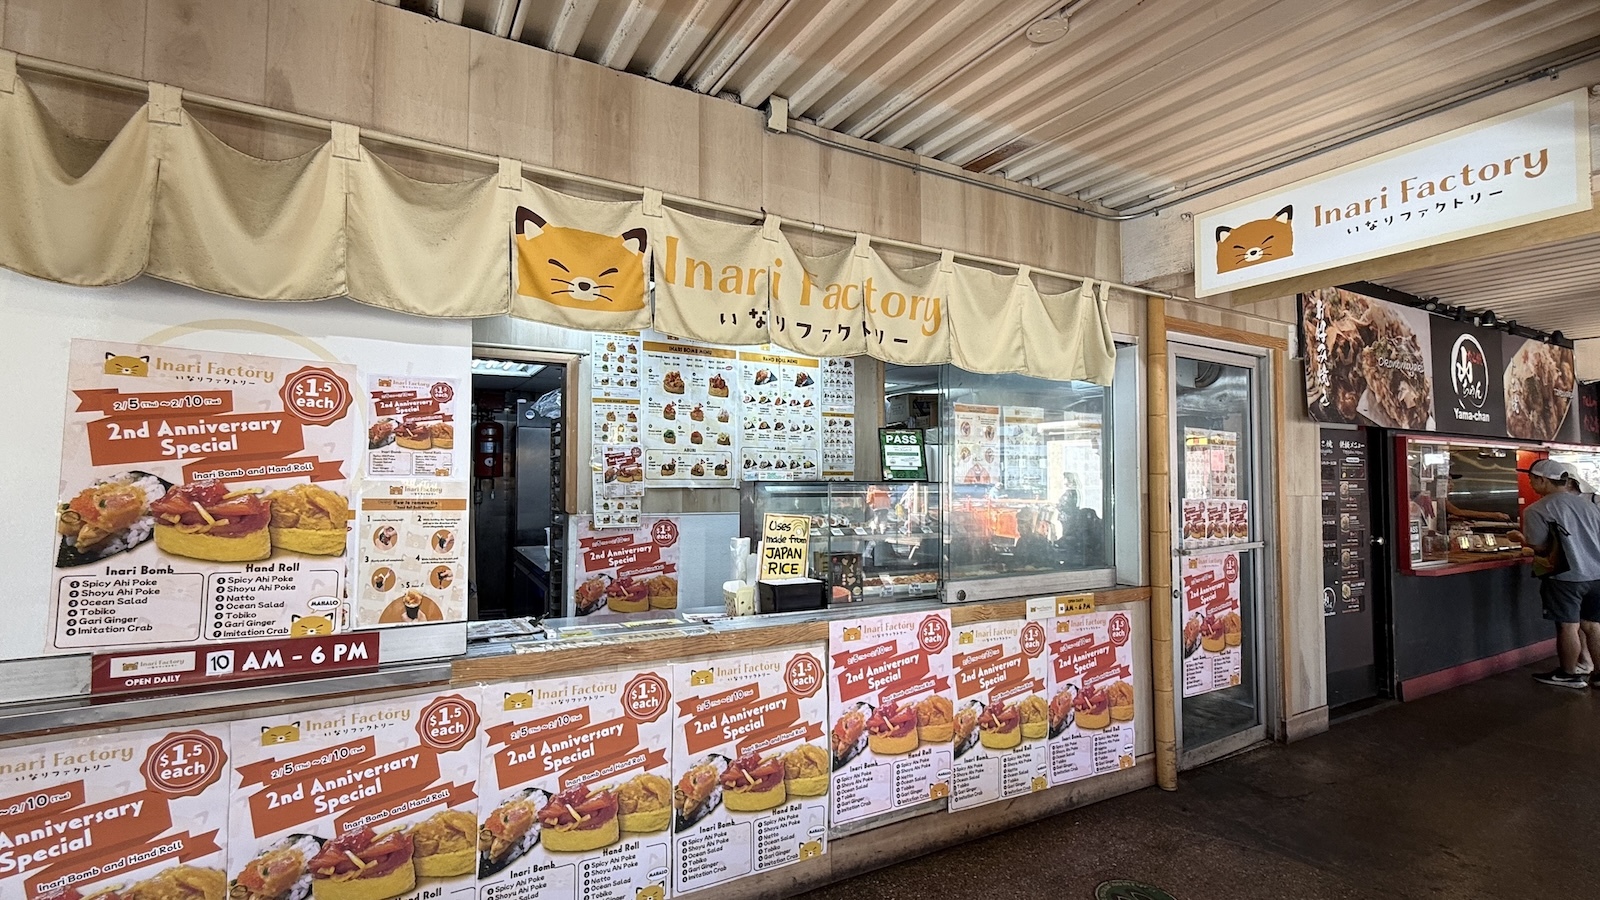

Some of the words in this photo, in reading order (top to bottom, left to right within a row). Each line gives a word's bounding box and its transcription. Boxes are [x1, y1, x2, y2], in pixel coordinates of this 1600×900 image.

[1314, 187, 1387, 228] Inari
[1400, 148, 1548, 204] Factory
[1347, 190, 1503, 235] いなりファクトリー
[665, 236, 783, 300] Inari
[800, 274, 942, 337] Factory
[720, 309, 908, 344] いなりファクトリー
[156, 357, 201, 375] Inari
[207, 362, 275, 383] Factory
[295, 379, 332, 397] $1.5
[296, 397, 334, 409] each
[1454, 408, 1490, 422] Yama-chan
[106, 421, 150, 440] 2nd
[157, 419, 282, 437] Anniversary
[161, 435, 238, 459] Special
[886, 435, 917, 444] PASS
[193, 470, 216, 480] Inari
[218, 468, 244, 478] Bomb
[248, 466, 265, 475] and
[268, 464, 291, 473] Hand
[292, 463, 313, 472] Roll
[769, 520, 791, 531] Uses
[766, 535, 786, 543] made
[789, 535, 806, 544] from
[590, 551, 605, 560] 2nd
[607, 545, 652, 558] Anniversary
[608, 555, 636, 567] Special
[766, 547, 802, 560] JAPAN
[106, 566, 136, 575] Inari
[141, 565, 174, 574] Bomb
[246, 563, 274, 572] Hand
[278, 563, 300, 571] Roll
[768, 562, 799, 574] RICE
[82, 580, 111, 588] Spicy
[78, 626, 125, 634] Imitation
[924, 634, 942, 644] each
[1112, 628, 1125, 637] each
[1024, 638, 1040, 648] each
[210, 655, 230, 671] 10
[242, 649, 284, 671] AM
[310, 646, 326, 664] 6
[334, 642, 368, 662] PM
[1058, 656, 1072, 669] 2nd
[1073, 645, 1110, 664] Anniversary
[1074, 657, 1097, 673] Special
[717, 666, 741, 677] Inari
[744, 662, 780, 673] Factory
[845, 671, 864, 684] 2nd
[866, 654, 919, 678] Anniversary
[961, 669, 976, 684] 2nd
[978, 657, 1022, 678] Anniversary
[125, 677, 152, 687] OPEN
[153, 675, 180, 684] DAILY
[793, 676, 814, 686] each
[868, 670, 901, 690] Special
[980, 671, 1007, 690] Special
[538, 688, 568, 699] Inari
[571, 682, 617, 695] Factory
[631, 683, 657, 700] $1.5
[632, 699, 659, 710] each
[305, 715, 346, 732] Inari
[351, 707, 411, 725] Factory
[429, 707, 462, 726] $1.5
[694, 716, 717, 734] 2nd
[721, 698, 787, 726] Anniversary
[431, 723, 464, 737] each
[724, 716, 765, 740] Special
[507, 743, 535, 766] 2nd
[540, 724, 623, 755] Anniversary
[0, 755, 46, 775] nari
[53, 747, 134, 767] Factory
[160, 744, 203, 767] $1.5
[544, 744, 595, 772] Special
[161, 762, 206, 780] each
[265, 782, 302, 809] 2nd
[310, 753, 419, 795] Anniversary
[314, 778, 382, 813] Special
[0, 800, 144, 849] Anniversary
[0, 828, 92, 873] Special
[603, 847, 623, 857] Hand
[625, 841, 639, 852] Roll
[38, 878, 65, 892] Inari
[67, 868, 99, 884] Bomb
[104, 859, 124, 872] and
[128, 849, 157, 864] Hand
[159, 841, 183, 854] Roll
[510, 867, 530, 879] Inari
[533, 861, 556, 873] Bomb
